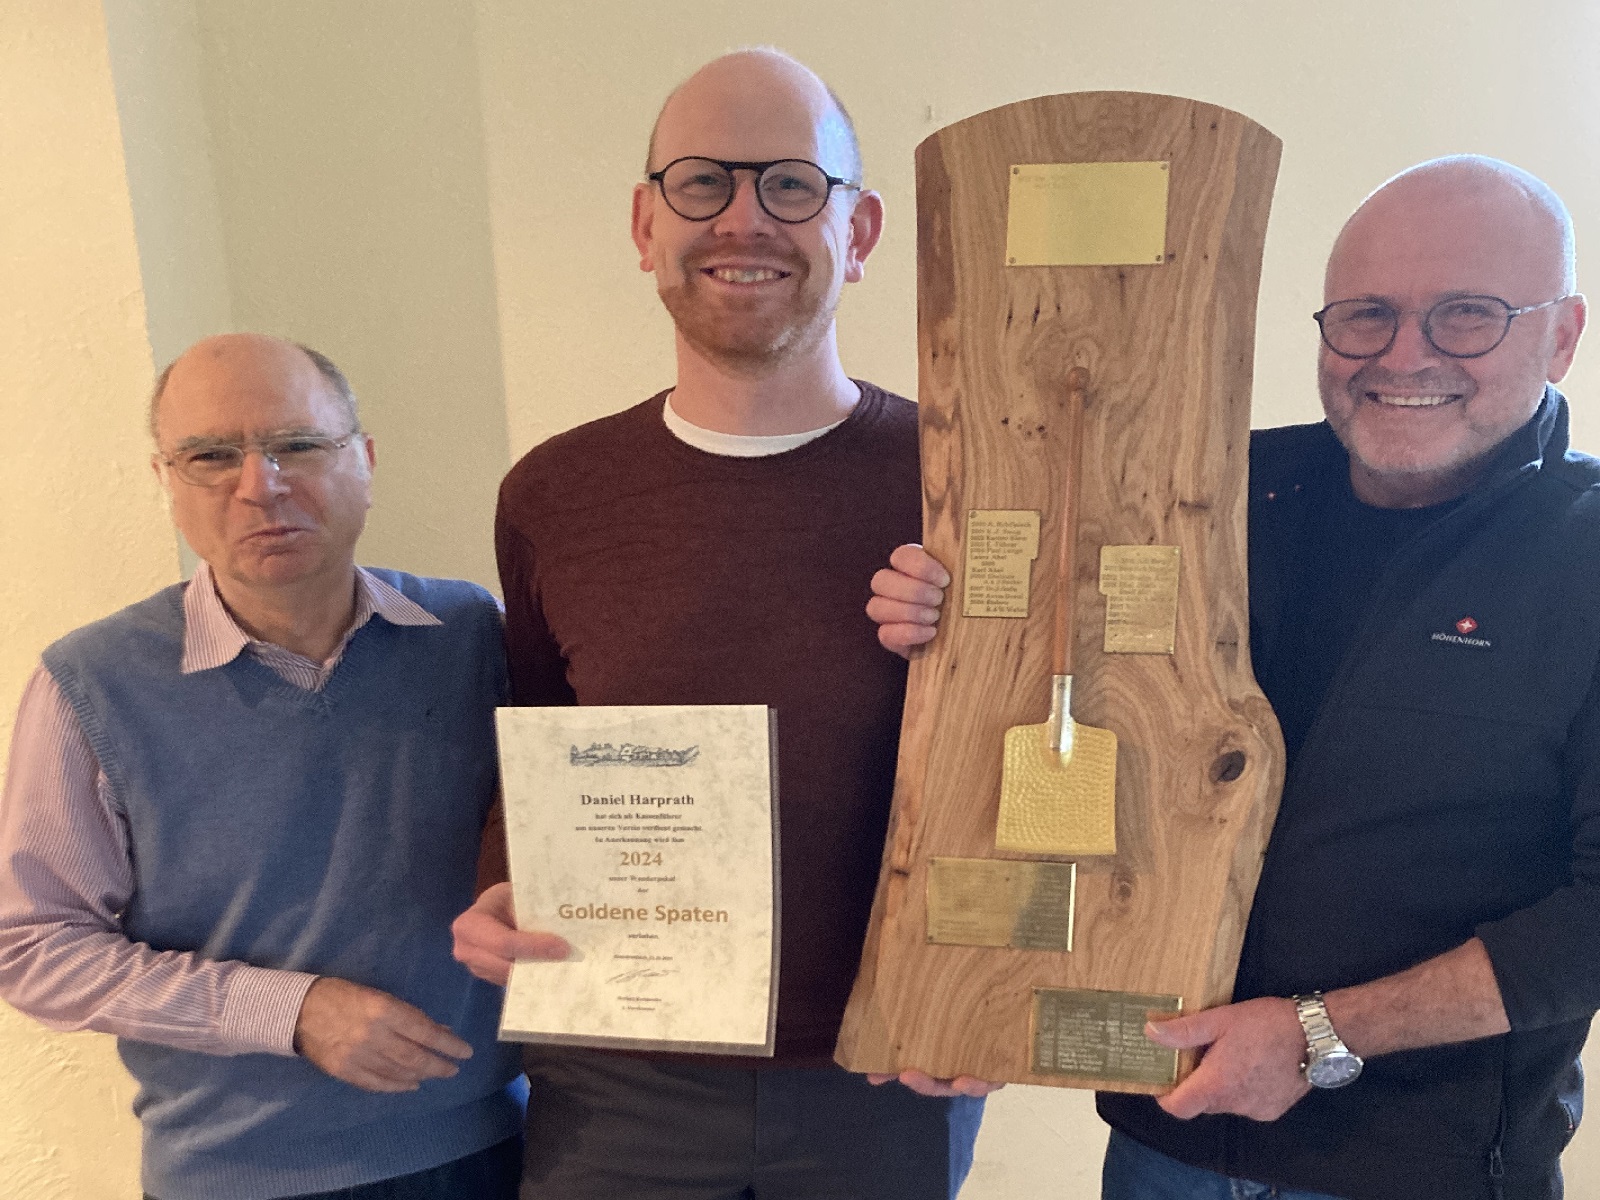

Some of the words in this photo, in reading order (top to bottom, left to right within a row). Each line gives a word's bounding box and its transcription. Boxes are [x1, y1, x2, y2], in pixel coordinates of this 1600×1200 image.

[581, 795, 625, 805] Daniel
[630, 795, 694, 808] Harprath
[620, 851, 663, 866] 2024
[558, 903, 648, 920] Goldene
[655, 904, 729, 924] Spaten
